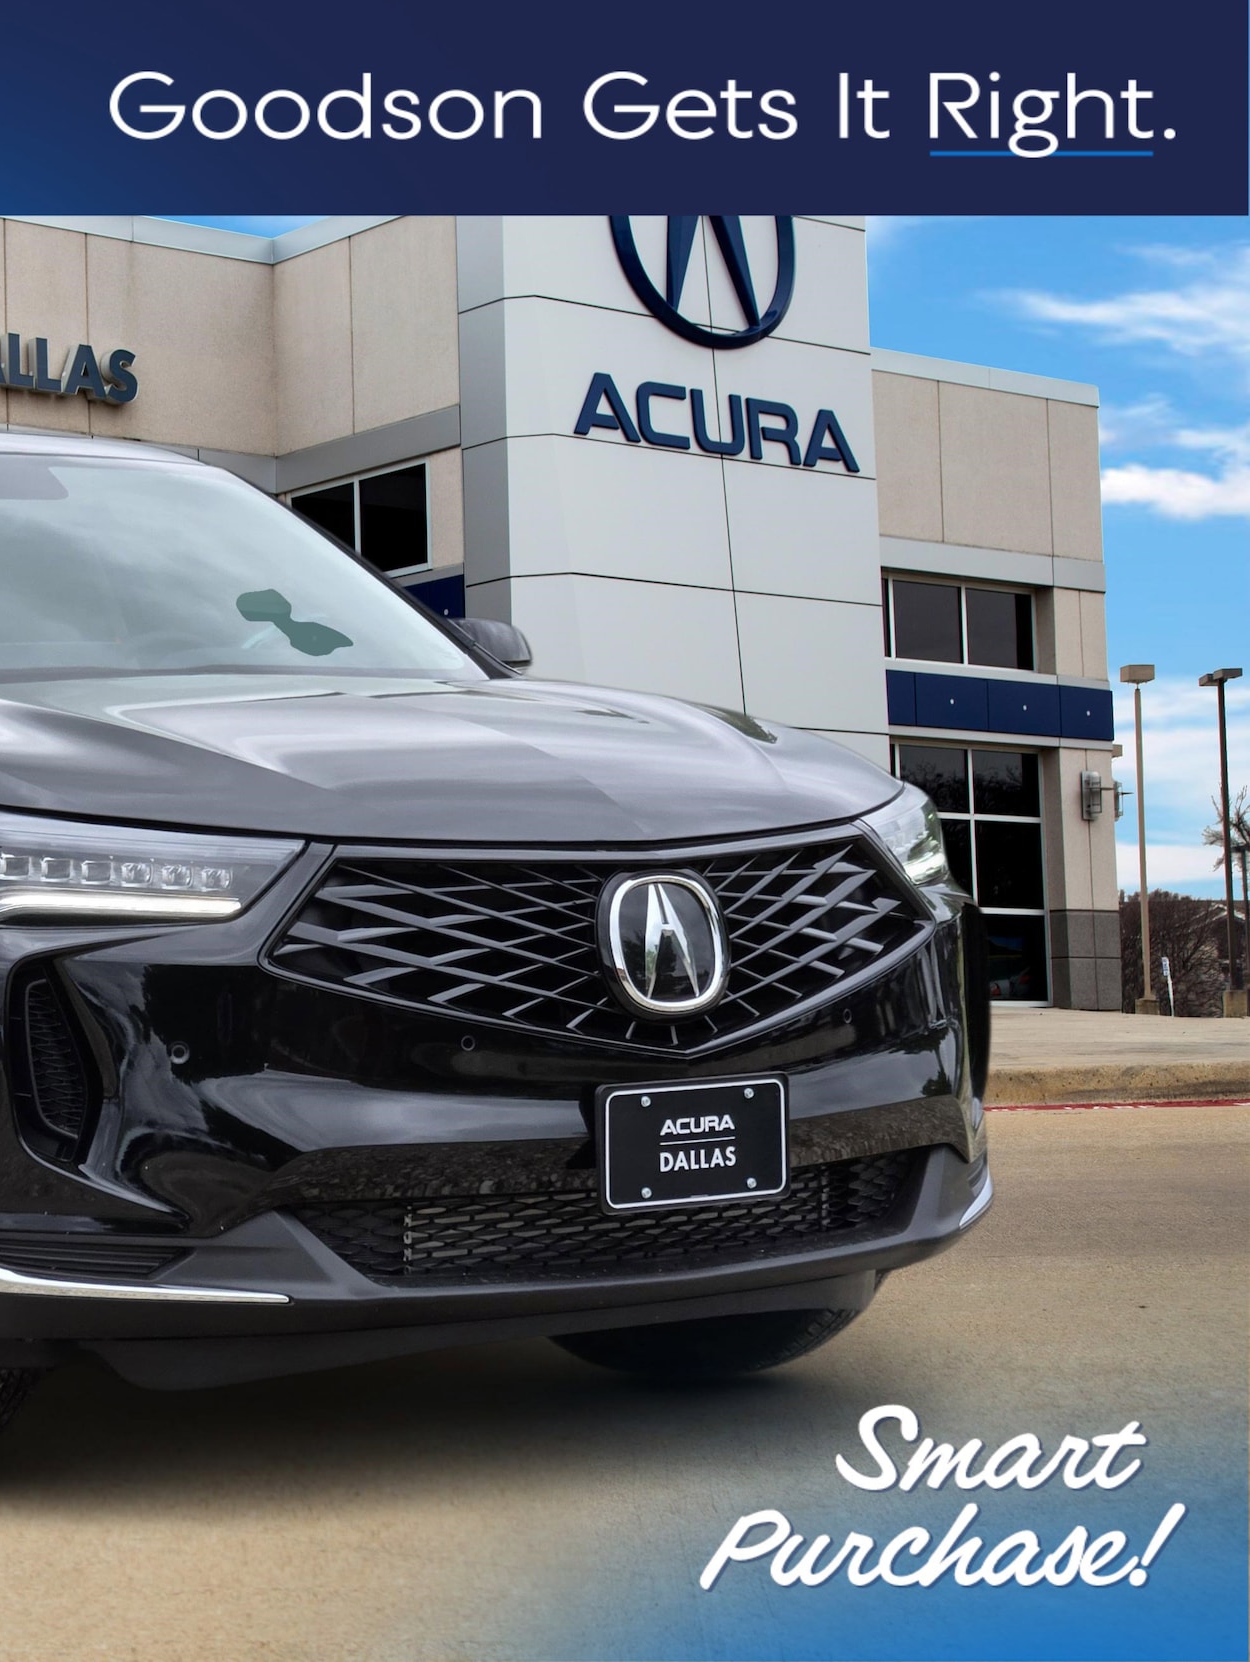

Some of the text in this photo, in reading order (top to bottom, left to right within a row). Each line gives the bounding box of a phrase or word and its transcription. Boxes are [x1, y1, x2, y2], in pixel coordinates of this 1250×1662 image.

[574, 372, 860, 473] ACURA
[659, 1114, 736, 1136] ACURA
[659, 1146, 737, 1173] DALLAS
